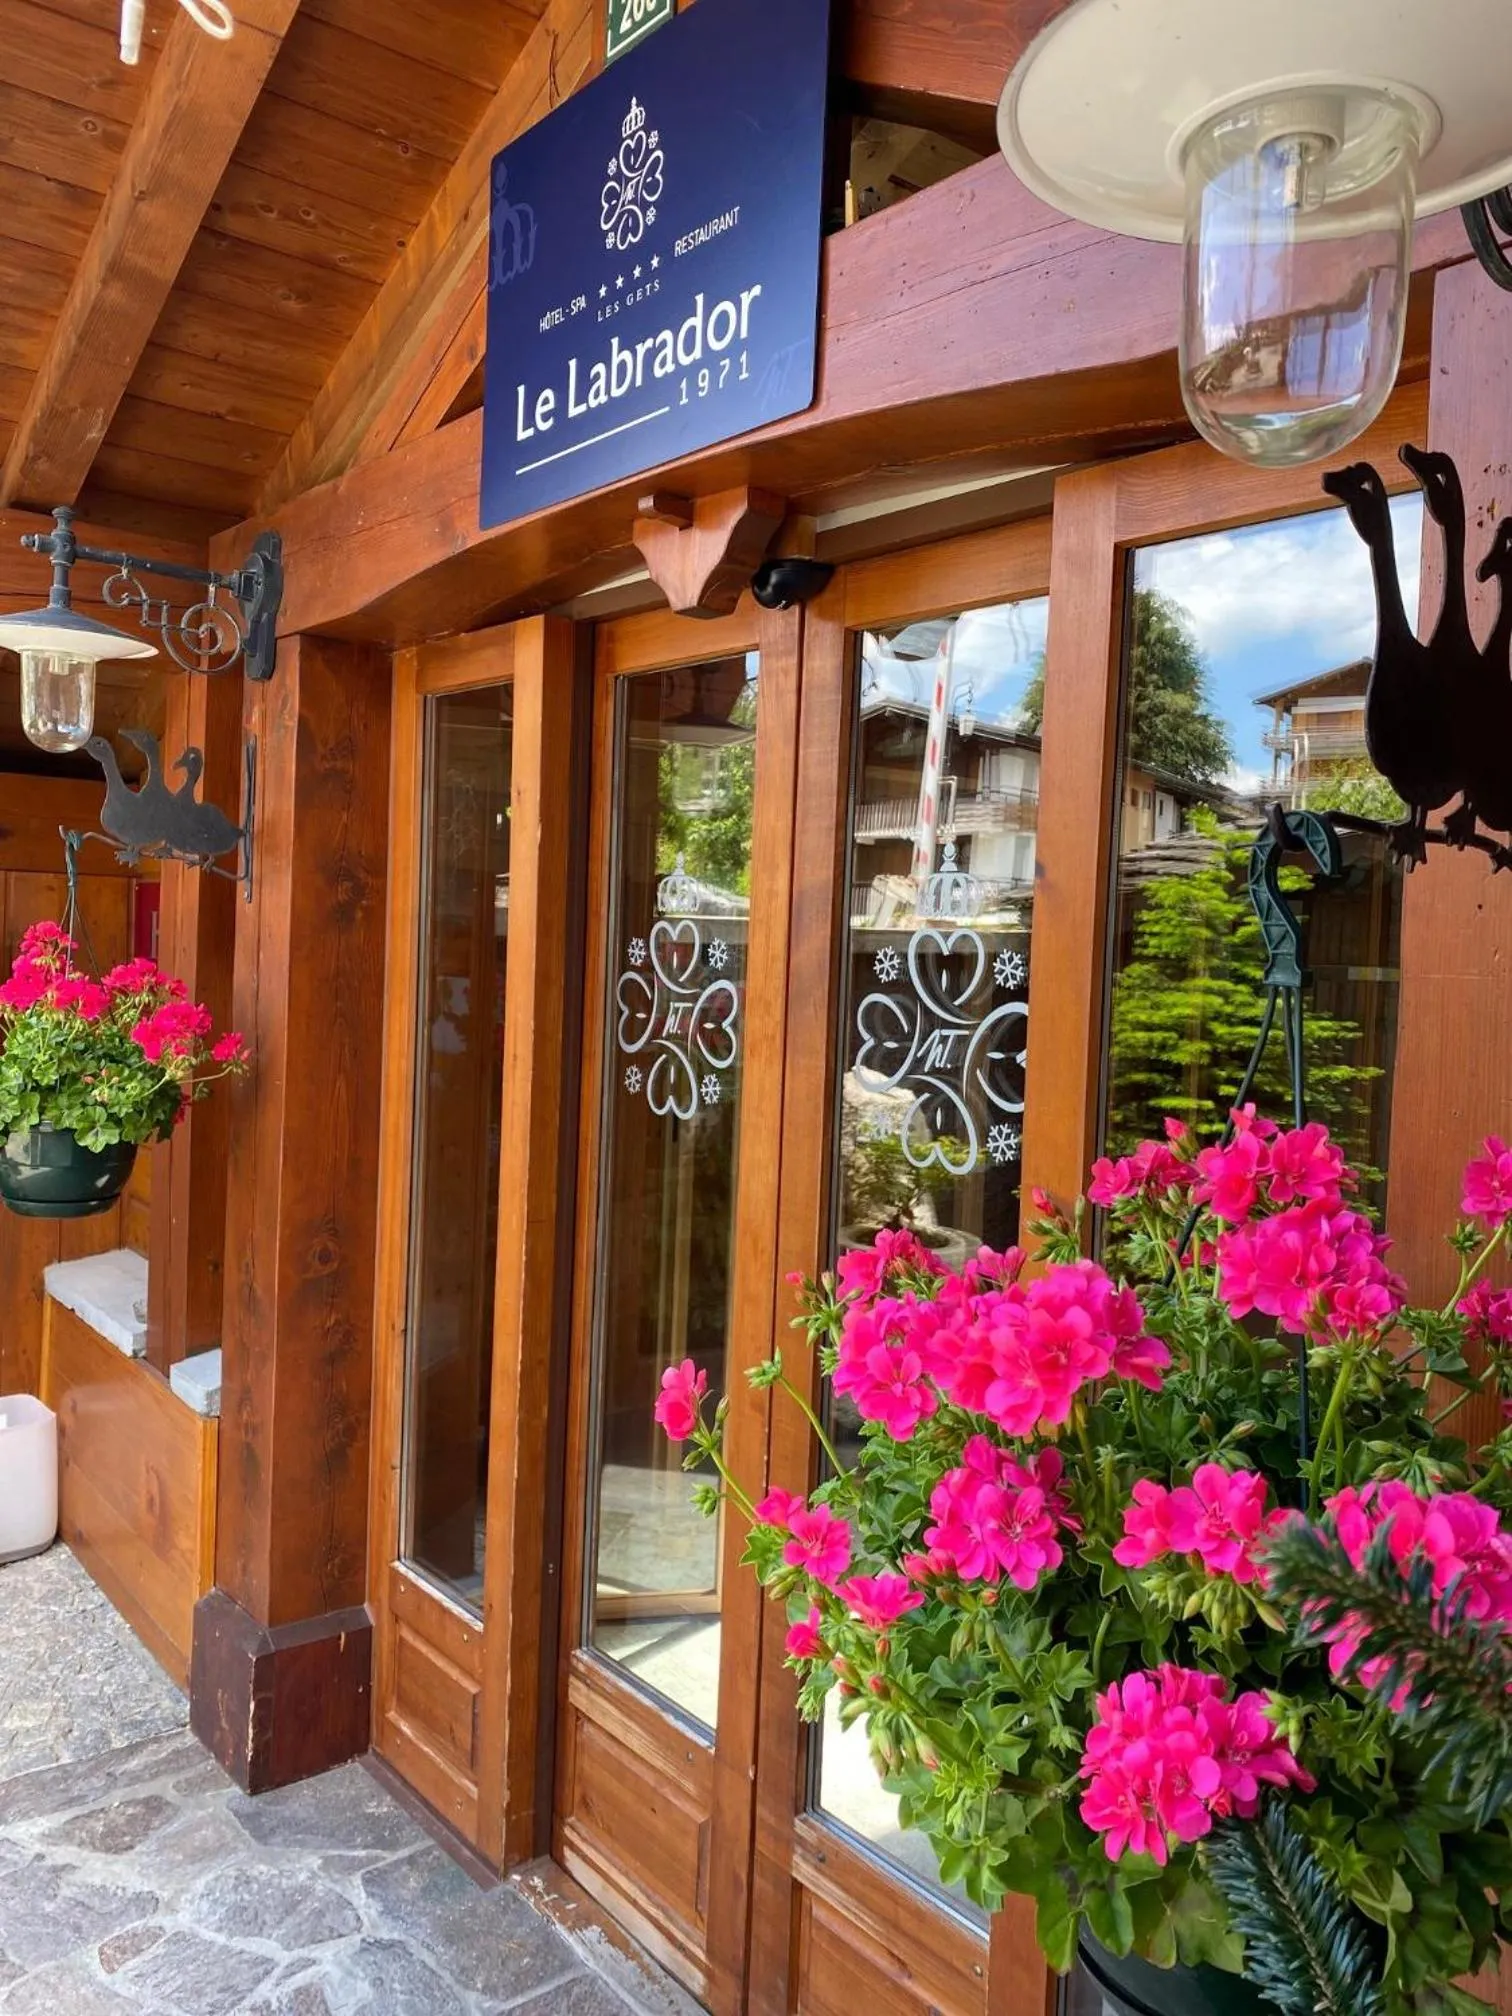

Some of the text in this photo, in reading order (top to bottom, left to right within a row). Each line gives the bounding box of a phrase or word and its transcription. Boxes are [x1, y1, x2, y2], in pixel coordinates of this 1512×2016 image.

[619, 0, 657, 34] 20
[674, 206, 741, 258] RESTAURANT
[597, 279, 660, 323] LES GETS
[516, 384, 555, 442] Le
[568, 284, 762, 419] Labrador
[679, 350, 750, 406] 1971
